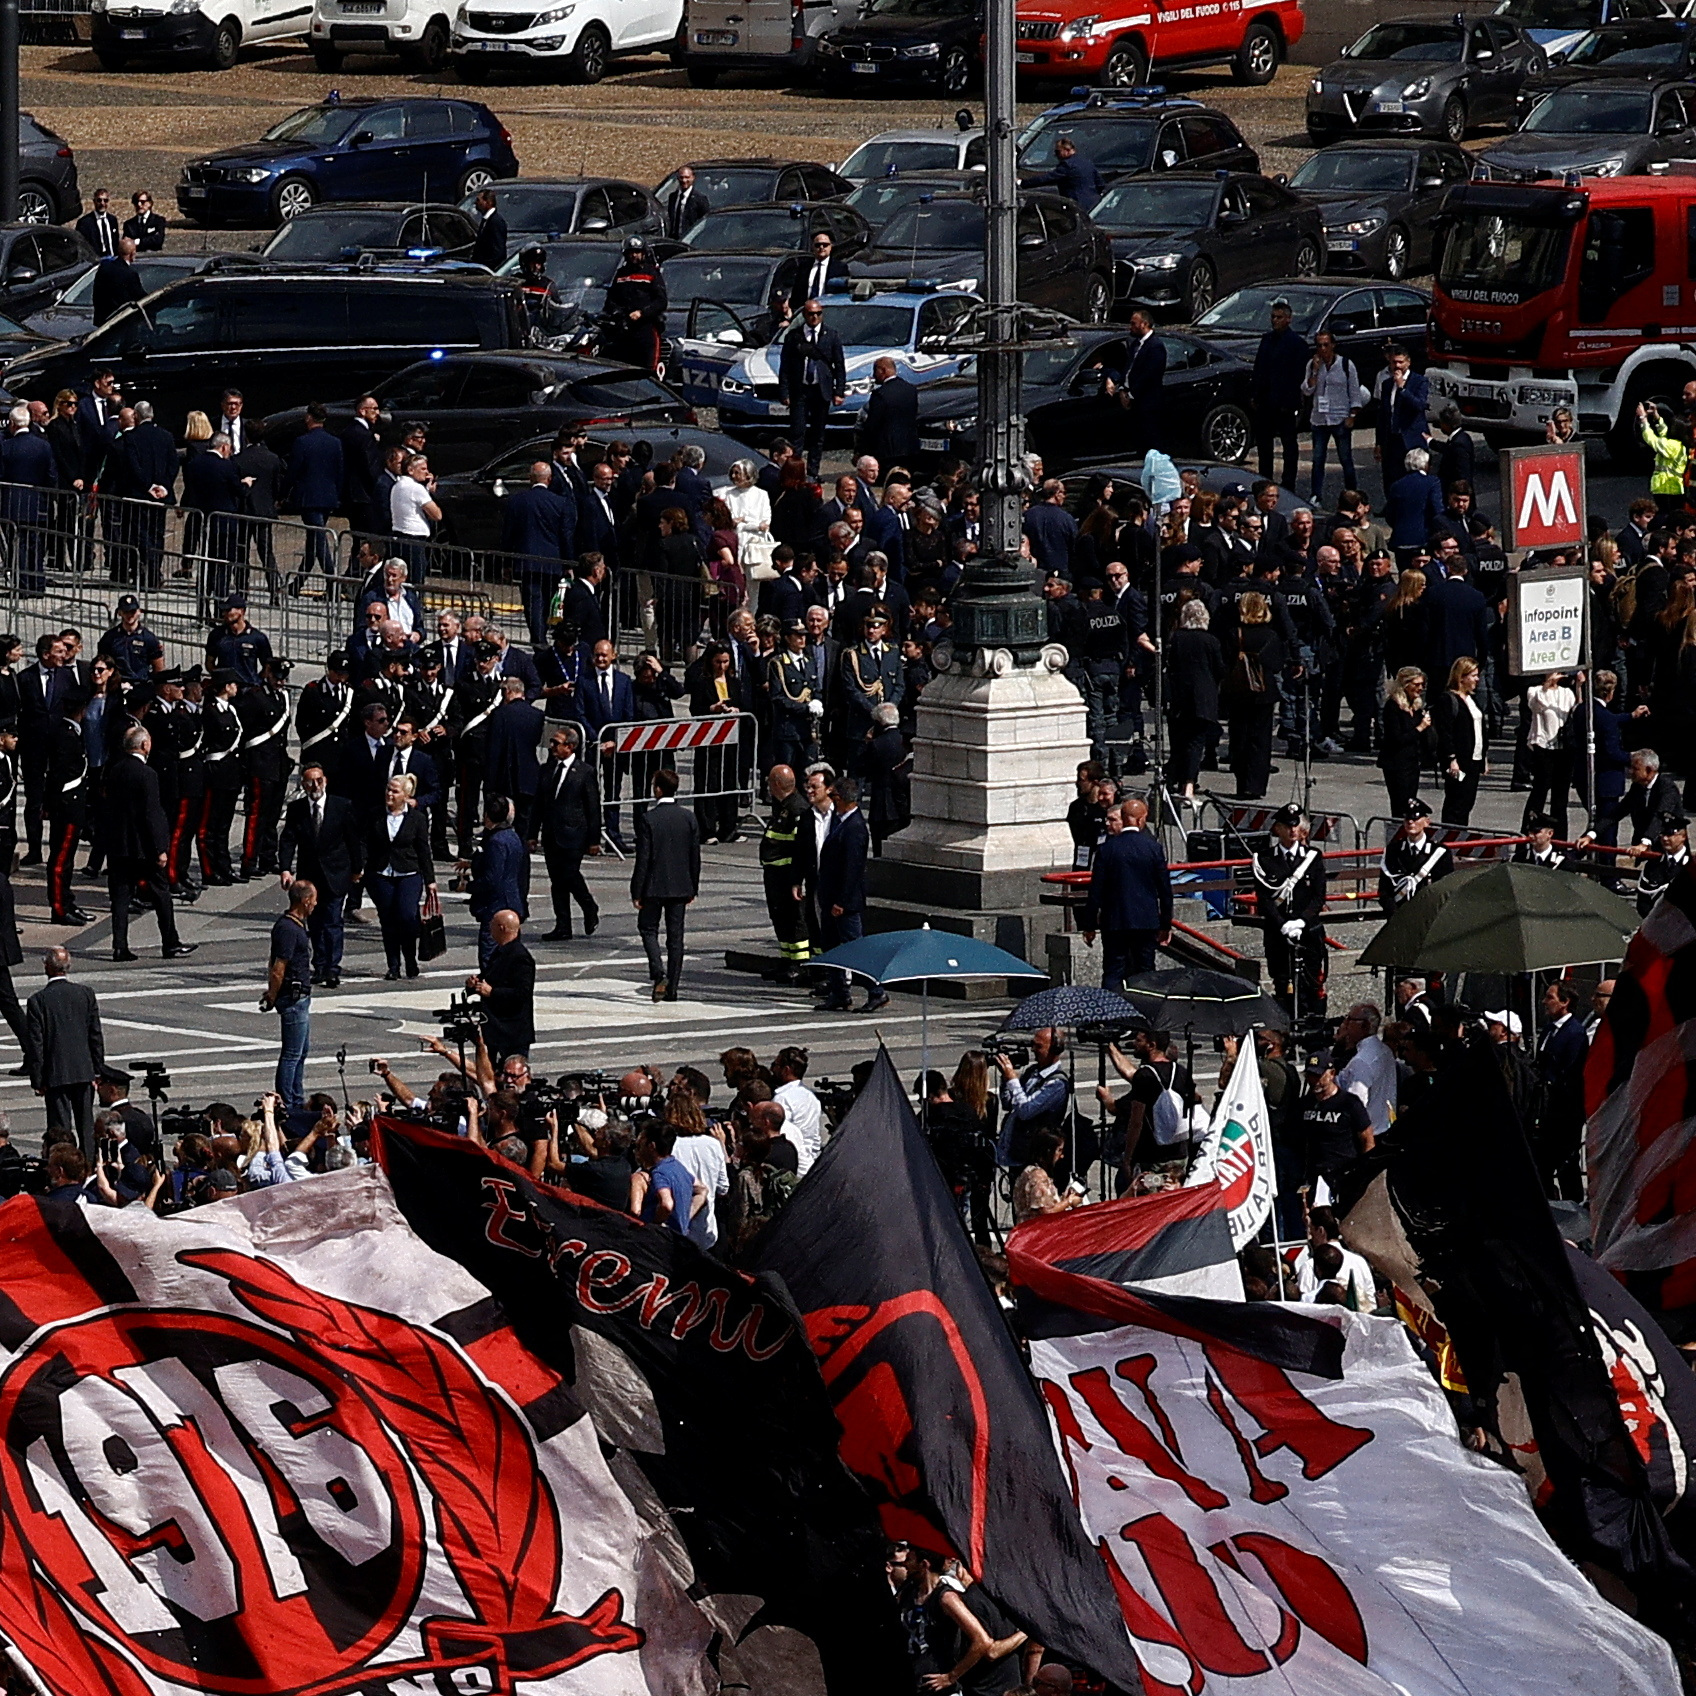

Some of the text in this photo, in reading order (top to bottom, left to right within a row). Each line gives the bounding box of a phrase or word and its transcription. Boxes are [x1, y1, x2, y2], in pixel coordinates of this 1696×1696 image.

[1157, 10, 1179, 23] VIGILI
[1180, 8, 1194, 19] DEL
[1195, 3, 1220, 17] FUOCO
[1474, 290, 1489, 301] DEL
[1491, 292, 1519, 304] FUOCO
[1461, 319, 1502, 334] IVECO
[1517, 470, 1577, 528] M
[1089, 615, 1120, 629] POLIZIA
[1524, 606, 1579, 624] infopoint
[1529, 626, 1572, 643] Area B
[1529, 647, 1571, 665] Area C
[27, 1355, 395, 1633] 1976
